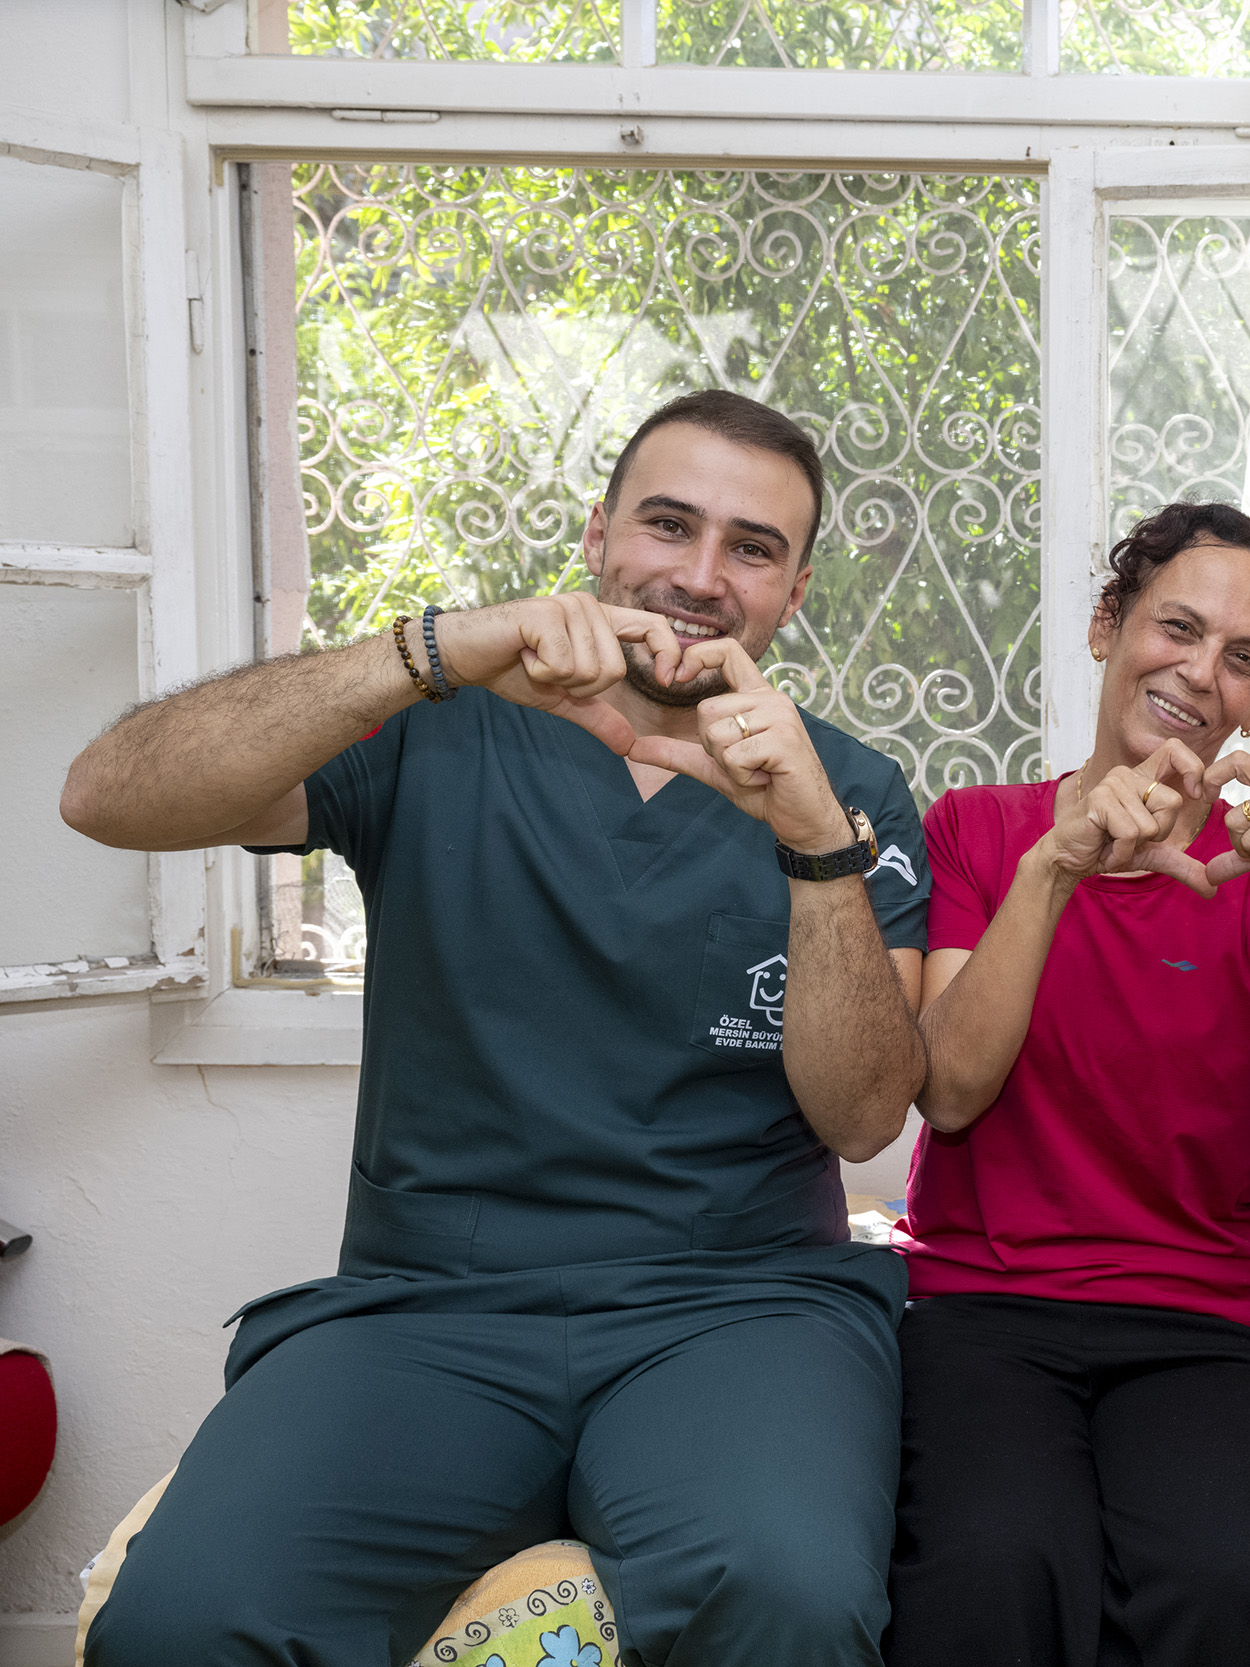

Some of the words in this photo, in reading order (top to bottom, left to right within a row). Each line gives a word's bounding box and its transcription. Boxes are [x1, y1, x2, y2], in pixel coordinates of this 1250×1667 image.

[720, 1014, 752, 1029] ÖZEL
[709, 1027, 750, 1039] MERSİN
[715, 1038, 743, 1047] EVDE
[745, 1040, 777, 1050] BAKIM
